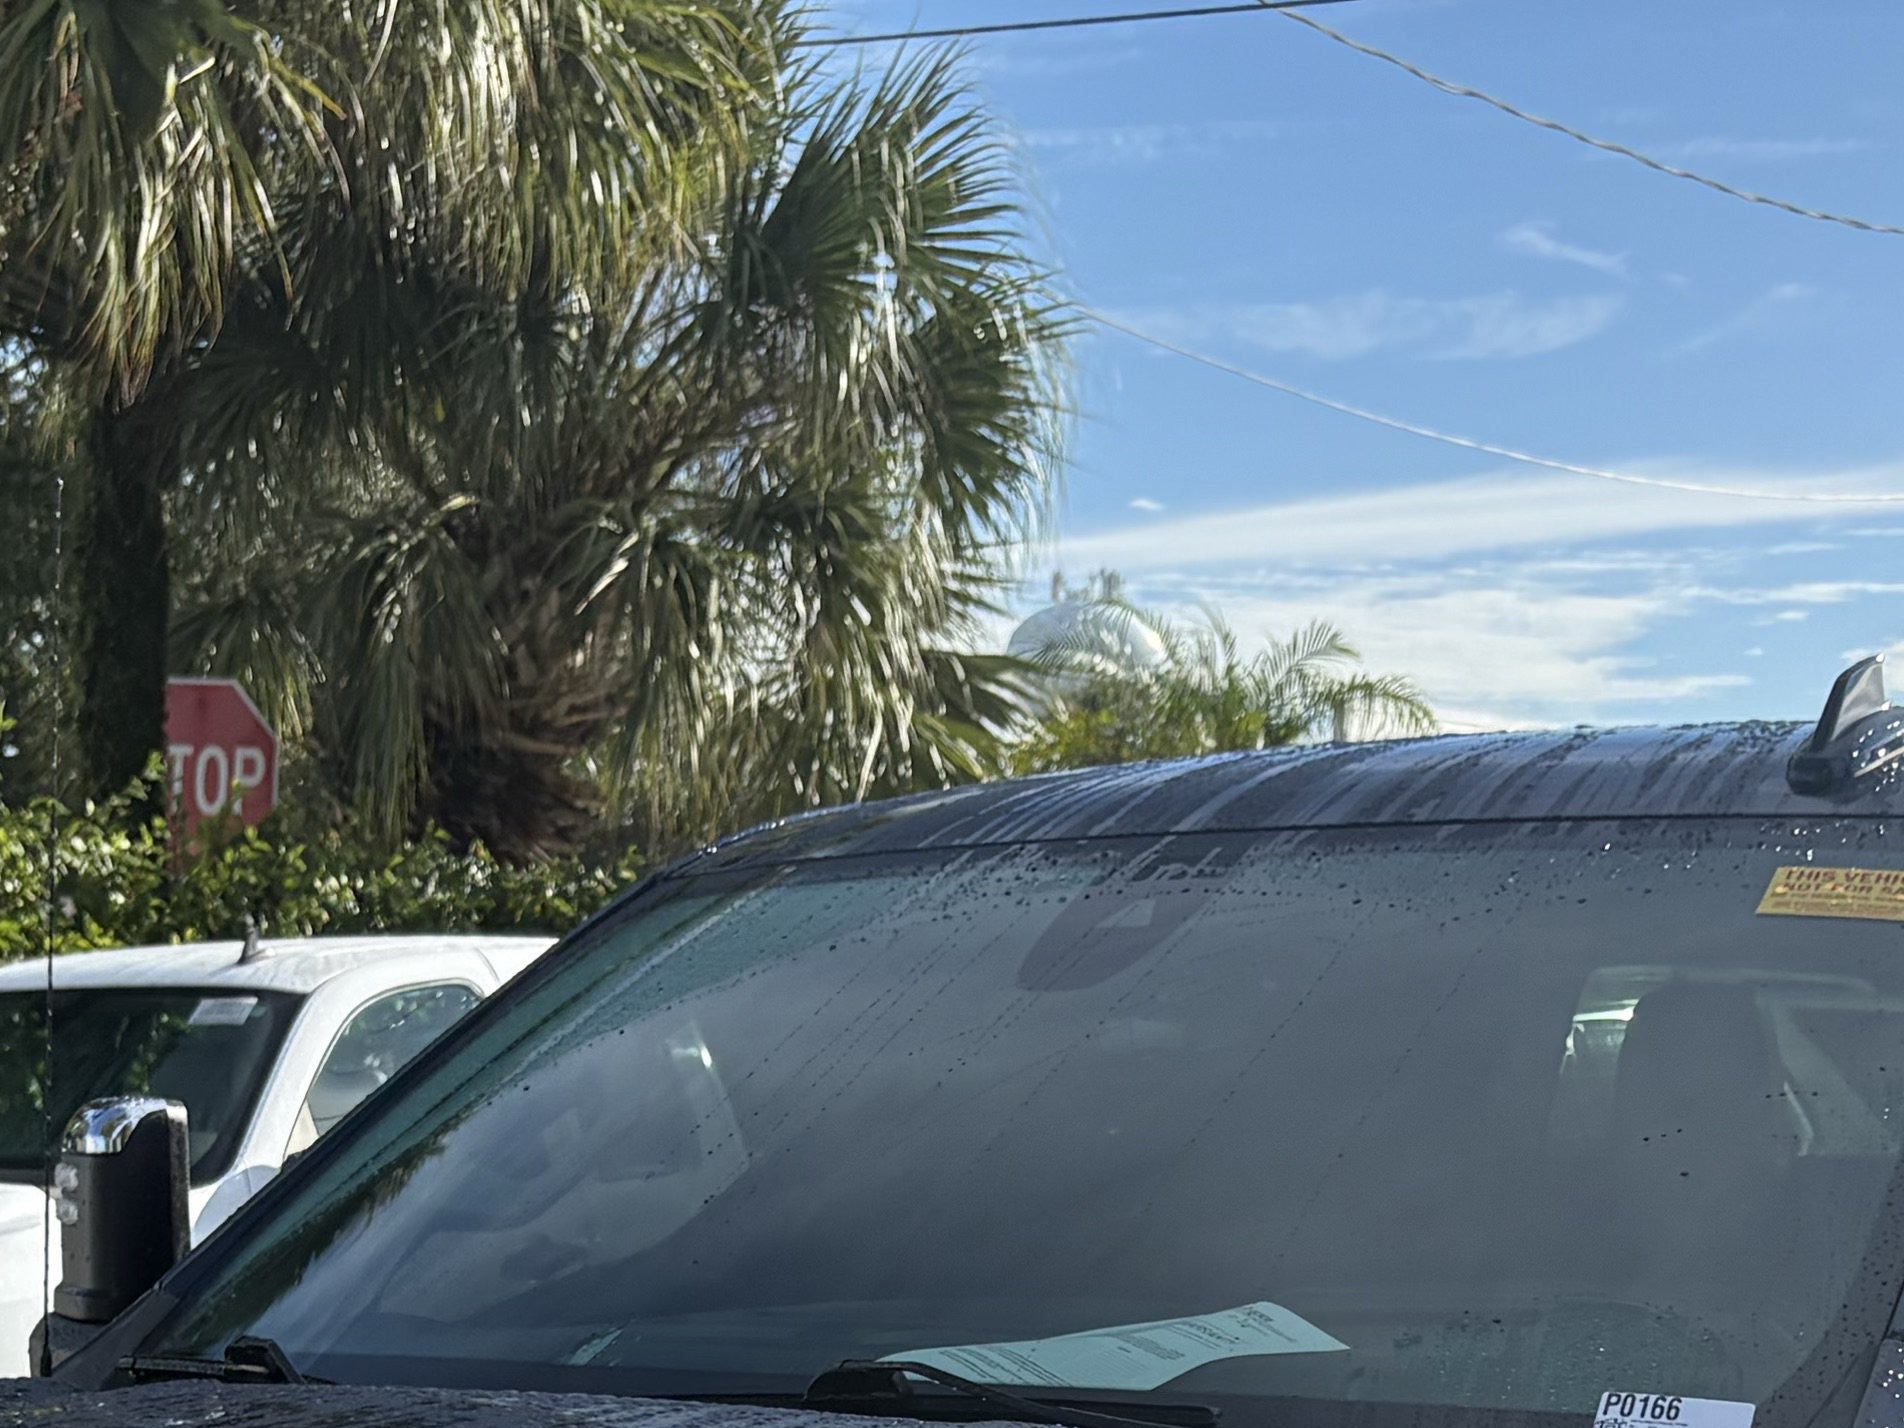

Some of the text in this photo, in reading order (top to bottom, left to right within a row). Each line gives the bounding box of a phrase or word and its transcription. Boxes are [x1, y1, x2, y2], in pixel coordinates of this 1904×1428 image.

[168, 745, 266, 816] TOP
[1785, 869, 1836, 882] THIS
[1782, 882, 1824, 892] NOT
[1830, 884, 1873, 894] FOR
[1603, 1393, 1682, 1420] P0166
